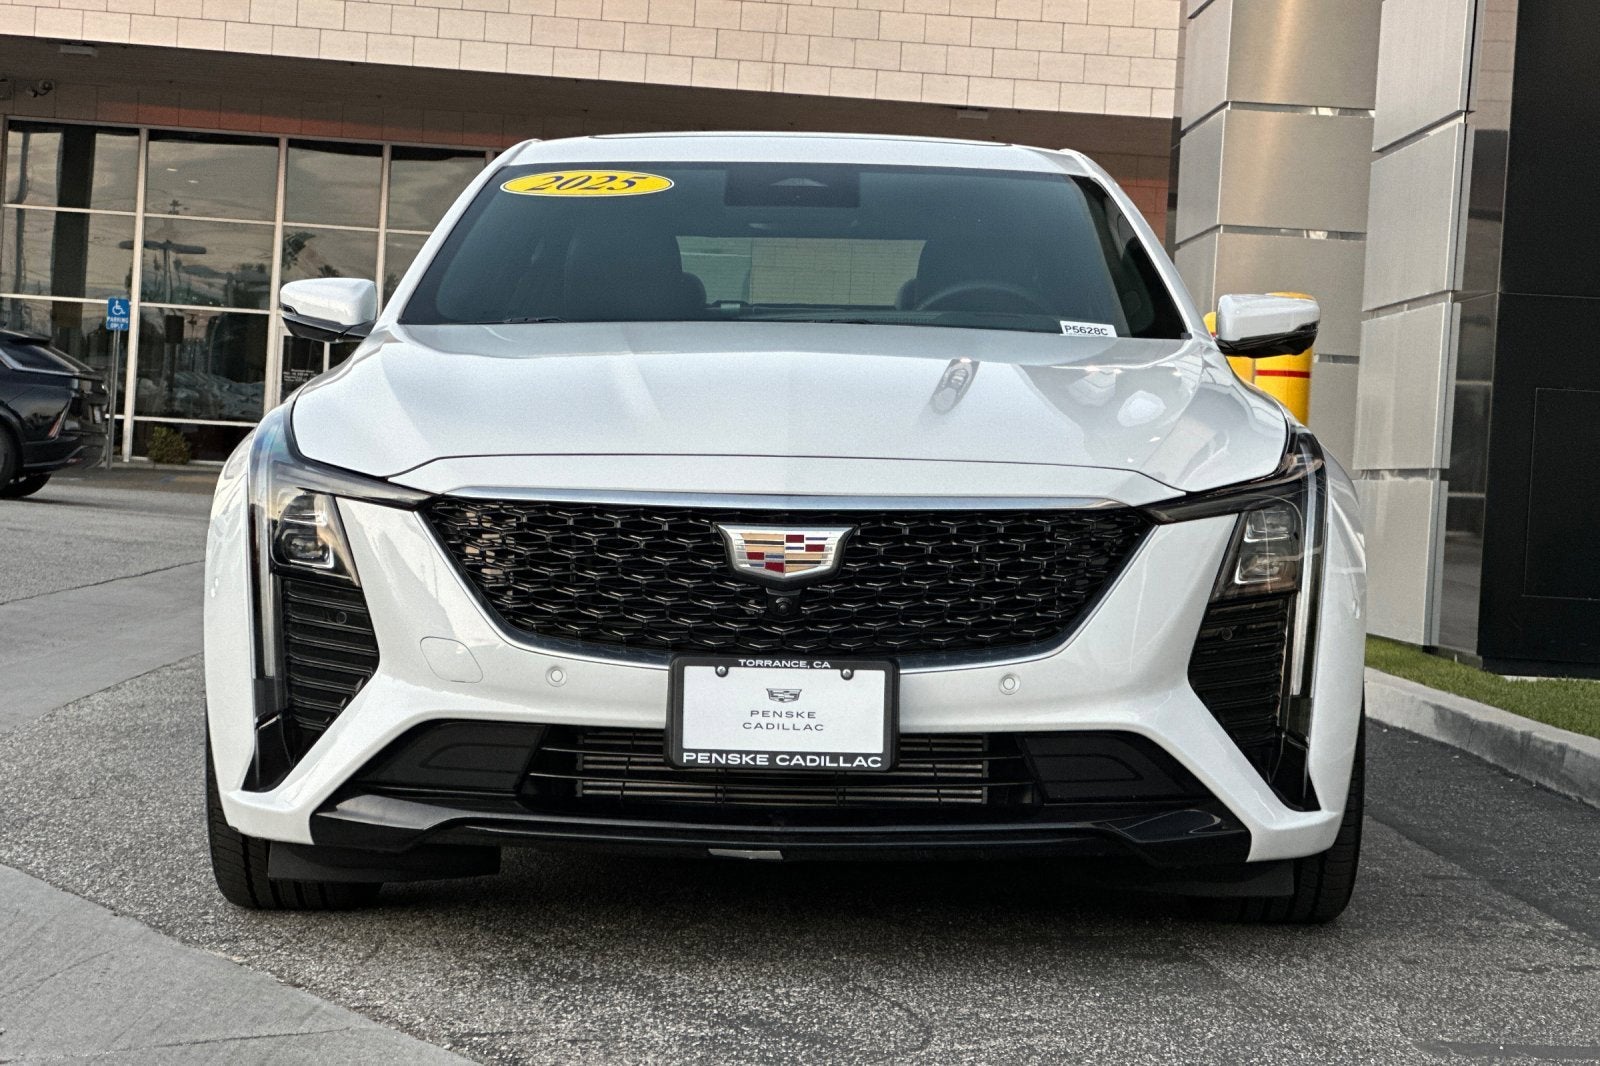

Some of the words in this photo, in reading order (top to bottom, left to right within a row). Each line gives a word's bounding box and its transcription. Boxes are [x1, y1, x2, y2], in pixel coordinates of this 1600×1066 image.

[525, 175, 648, 191] 2025
[1064, 325, 1109, 336] P5628C
[738, 659, 810, 669] TORRANCE,
[813, 660, 831, 669] CA
[750, 710, 817, 719] PENSKE
[742, 722, 824, 731] CADILLAC
[683, 752, 770, 766] PENSKE
[776, 755, 882, 768] CADILLAC
